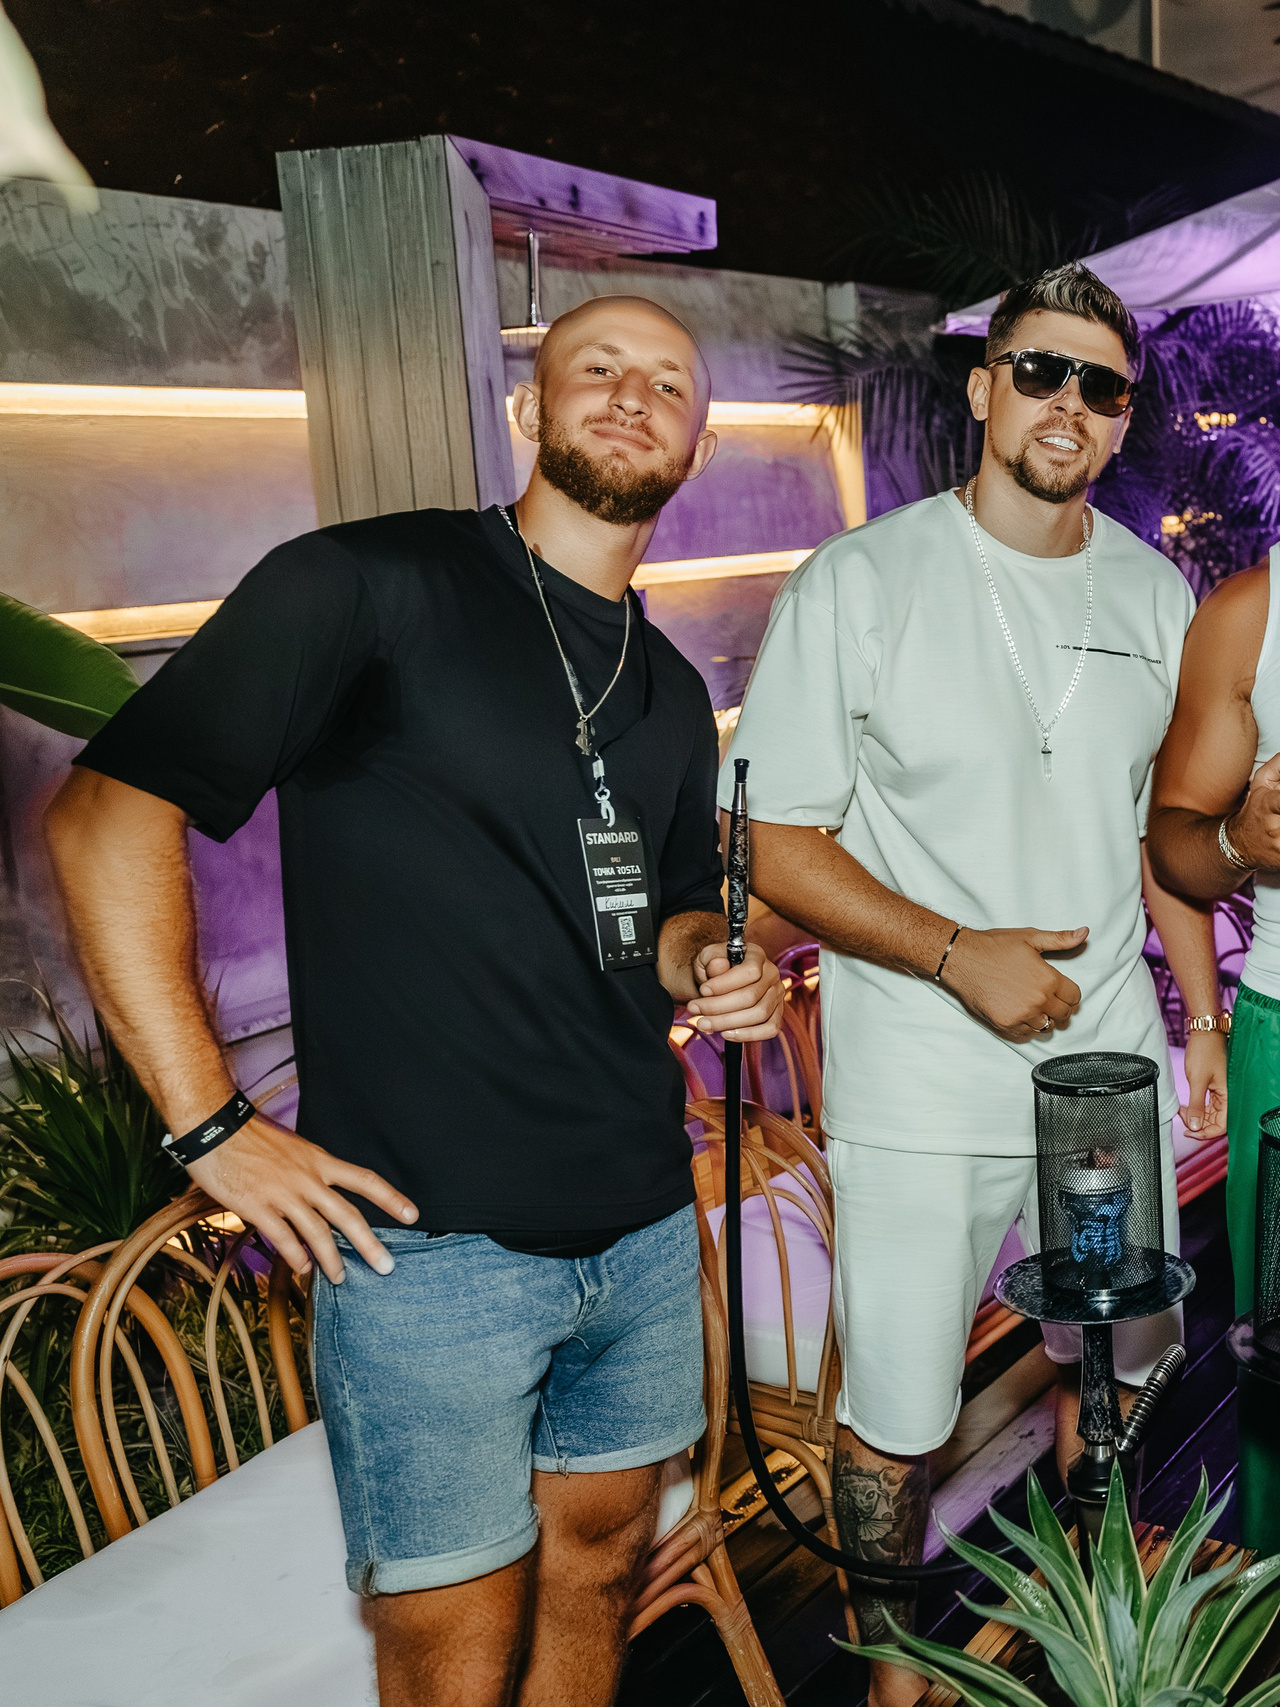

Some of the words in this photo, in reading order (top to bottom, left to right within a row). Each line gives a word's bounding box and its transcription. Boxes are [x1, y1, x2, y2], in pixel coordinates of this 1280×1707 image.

[585, 831, 639, 845] STANDARD
[592, 867, 616, 877] ТОЧКА
[615, 865, 642, 875] ROSTA
